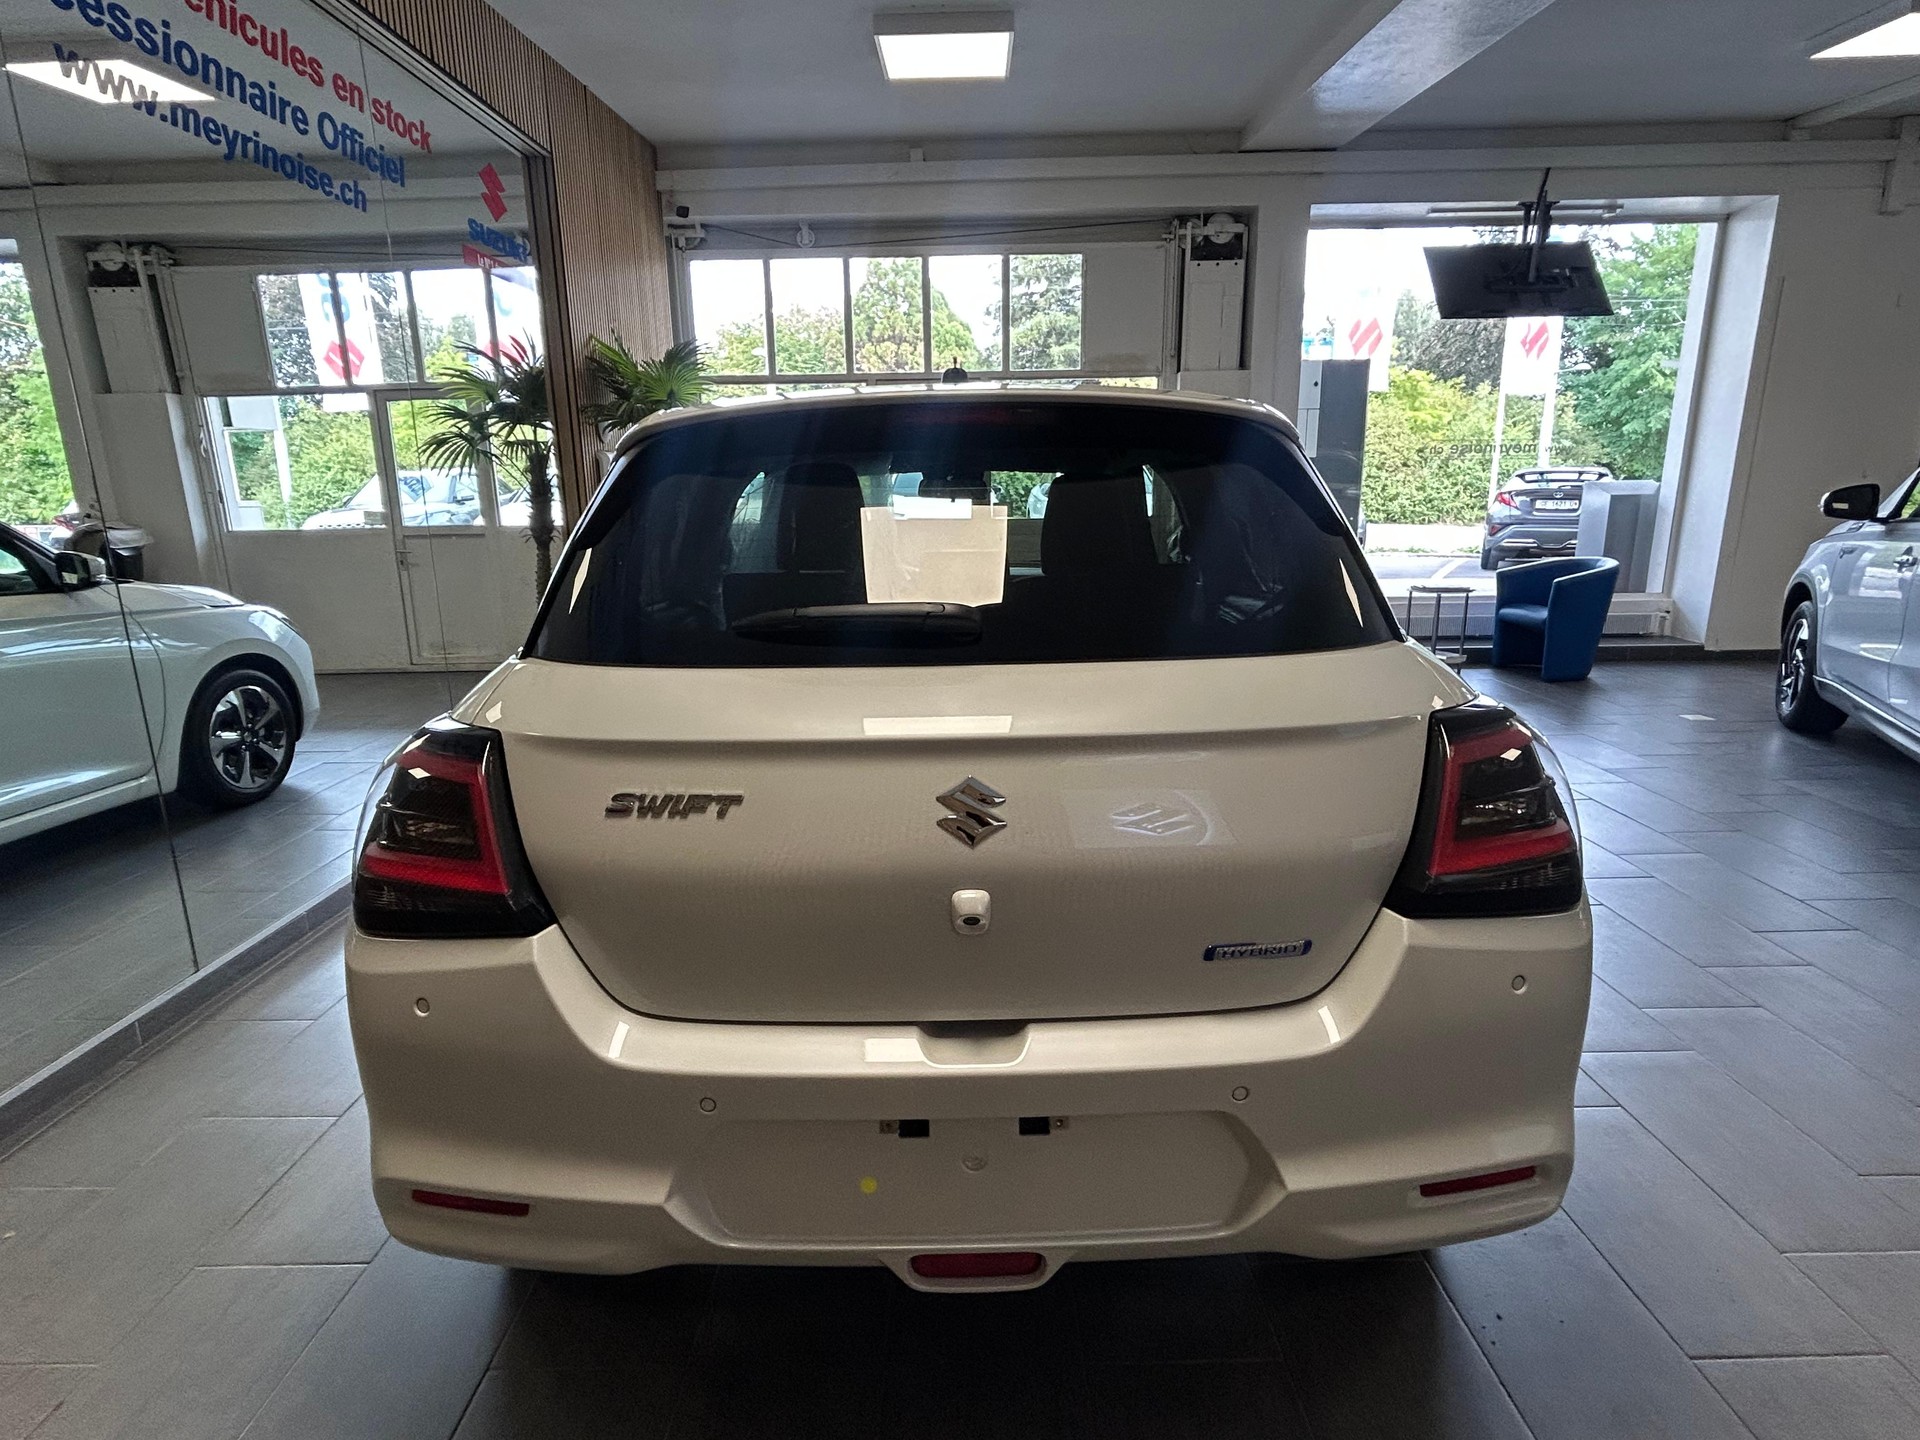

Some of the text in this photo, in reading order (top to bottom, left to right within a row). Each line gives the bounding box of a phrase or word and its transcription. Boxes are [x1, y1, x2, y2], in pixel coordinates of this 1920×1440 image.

[53, 42, 368, 213] www.meyrinoise.ch
[317, 111, 406, 188] Officiel
[331, 73, 365, 114] en
[371, 97, 433, 154] stock
[604, 791, 745, 820] SWIFT
[1220, 943, 1299, 959] HYBRID
